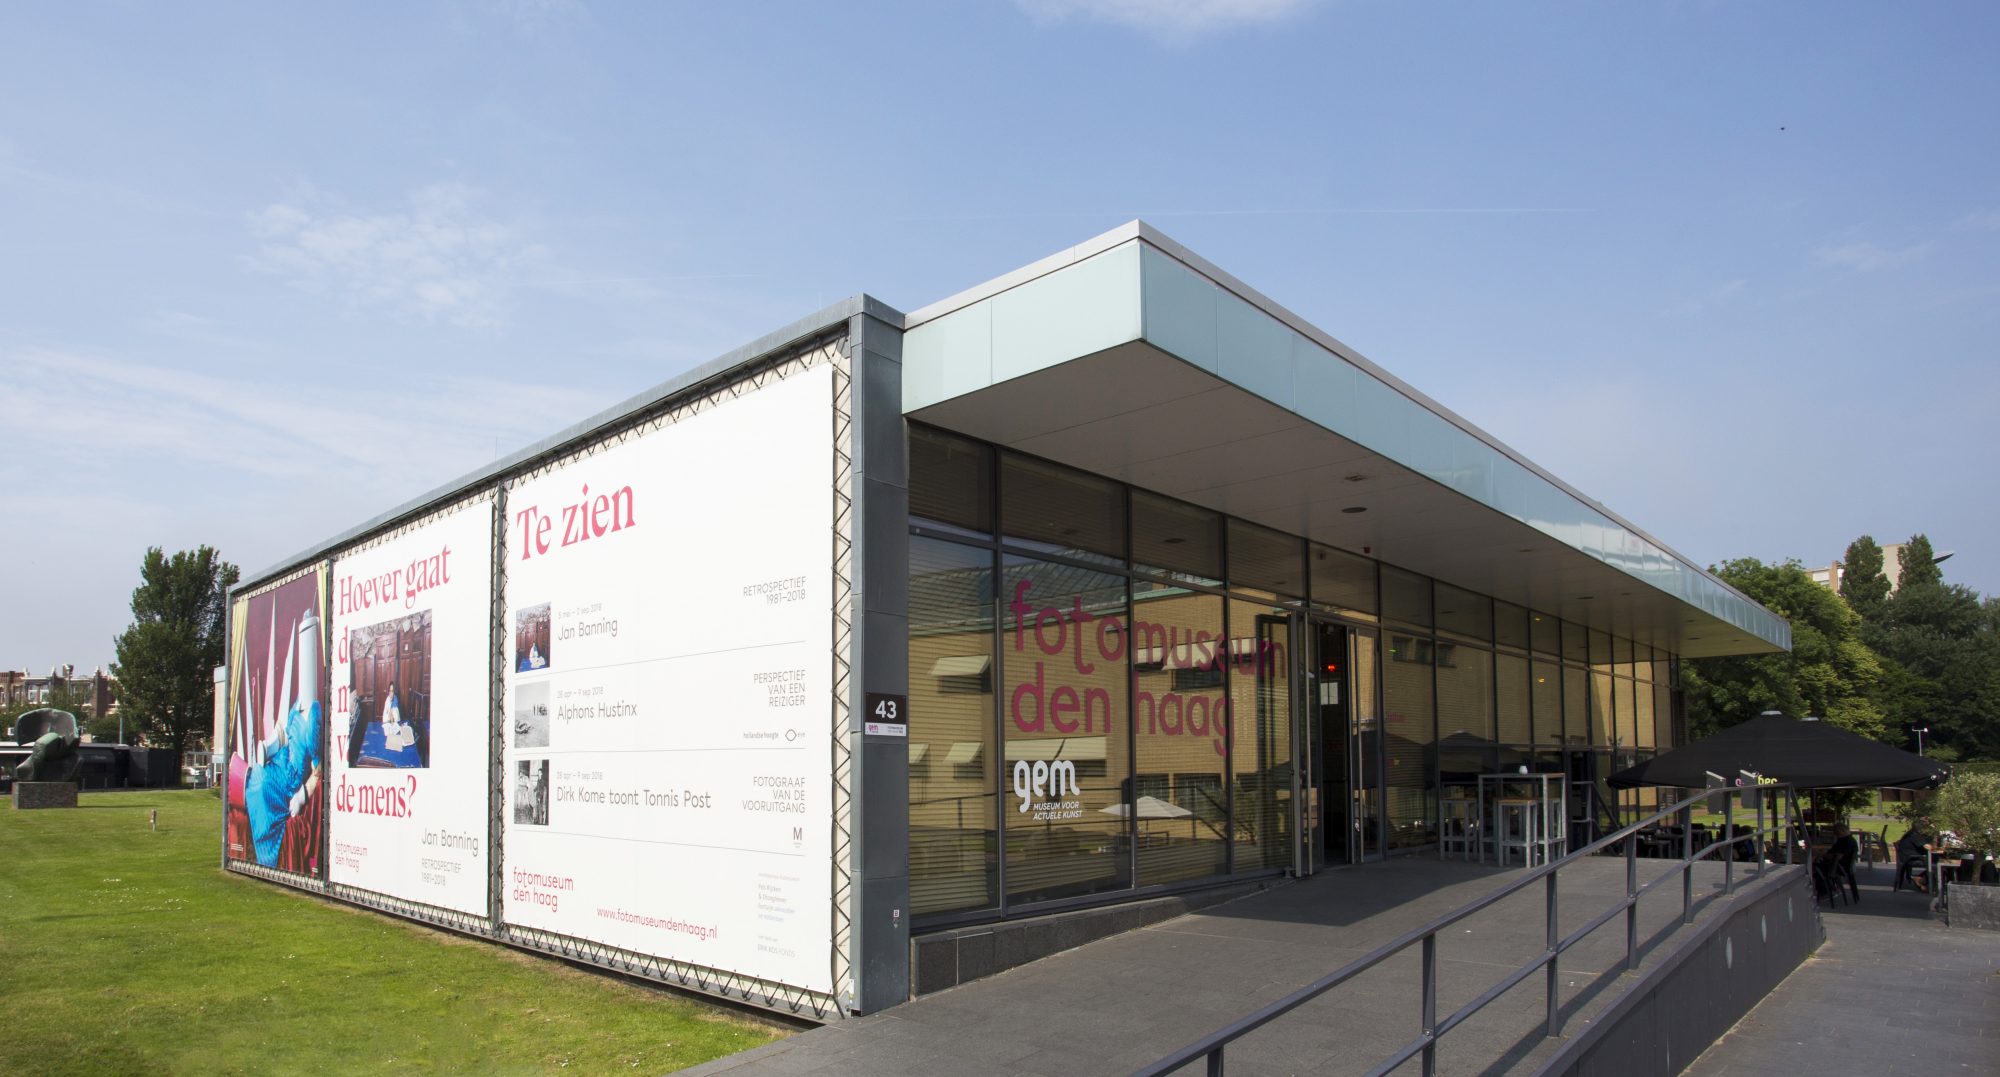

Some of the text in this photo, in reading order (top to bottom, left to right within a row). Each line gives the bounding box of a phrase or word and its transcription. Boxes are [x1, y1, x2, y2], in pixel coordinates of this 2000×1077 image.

[517, 482, 636, 560] Te zien
[339, 544, 452, 615] Hoever gaat
[743, 576, 807, 598] RETROSPECTIEF
[558, 617, 618, 642] Jan Banning
[1011, 580, 1286, 677] fotomuseum
[754, 669, 806, 684] PERSPECTIEF
[768, 682, 806, 694] VAN EEN
[558, 700, 637, 724] Alphons Hustinx
[769, 694, 806, 708] REIZIGER
[875, 700, 897, 719] 43
[1012, 662, 1111, 734] den
[1136, 670, 1236, 757] haag
[753, 776, 806, 787] FOTOGRAAF
[1013, 760, 1080, 814] gem
[336, 773, 417, 818] de mens?
[556, 786, 712, 809] Dirk Kome toont Tonnis Post
[742, 800, 806, 814] VOORUITGANG
[773, 790, 806, 801] VAN DE
[1033, 802, 1080, 811] MUSEUM VOOR
[1033, 810, 1082, 821] ACTUELE KUNST
[422, 828, 479, 856] Jan Banning
[793, 827, 802, 841] M
[422, 858, 462, 874] RETROSPECTIEF
[513, 866, 574, 892] fotomuseum
[513, 886, 558, 913] den haag
[597, 904, 718, 940] www.fotomuseumdenhaag.nl
